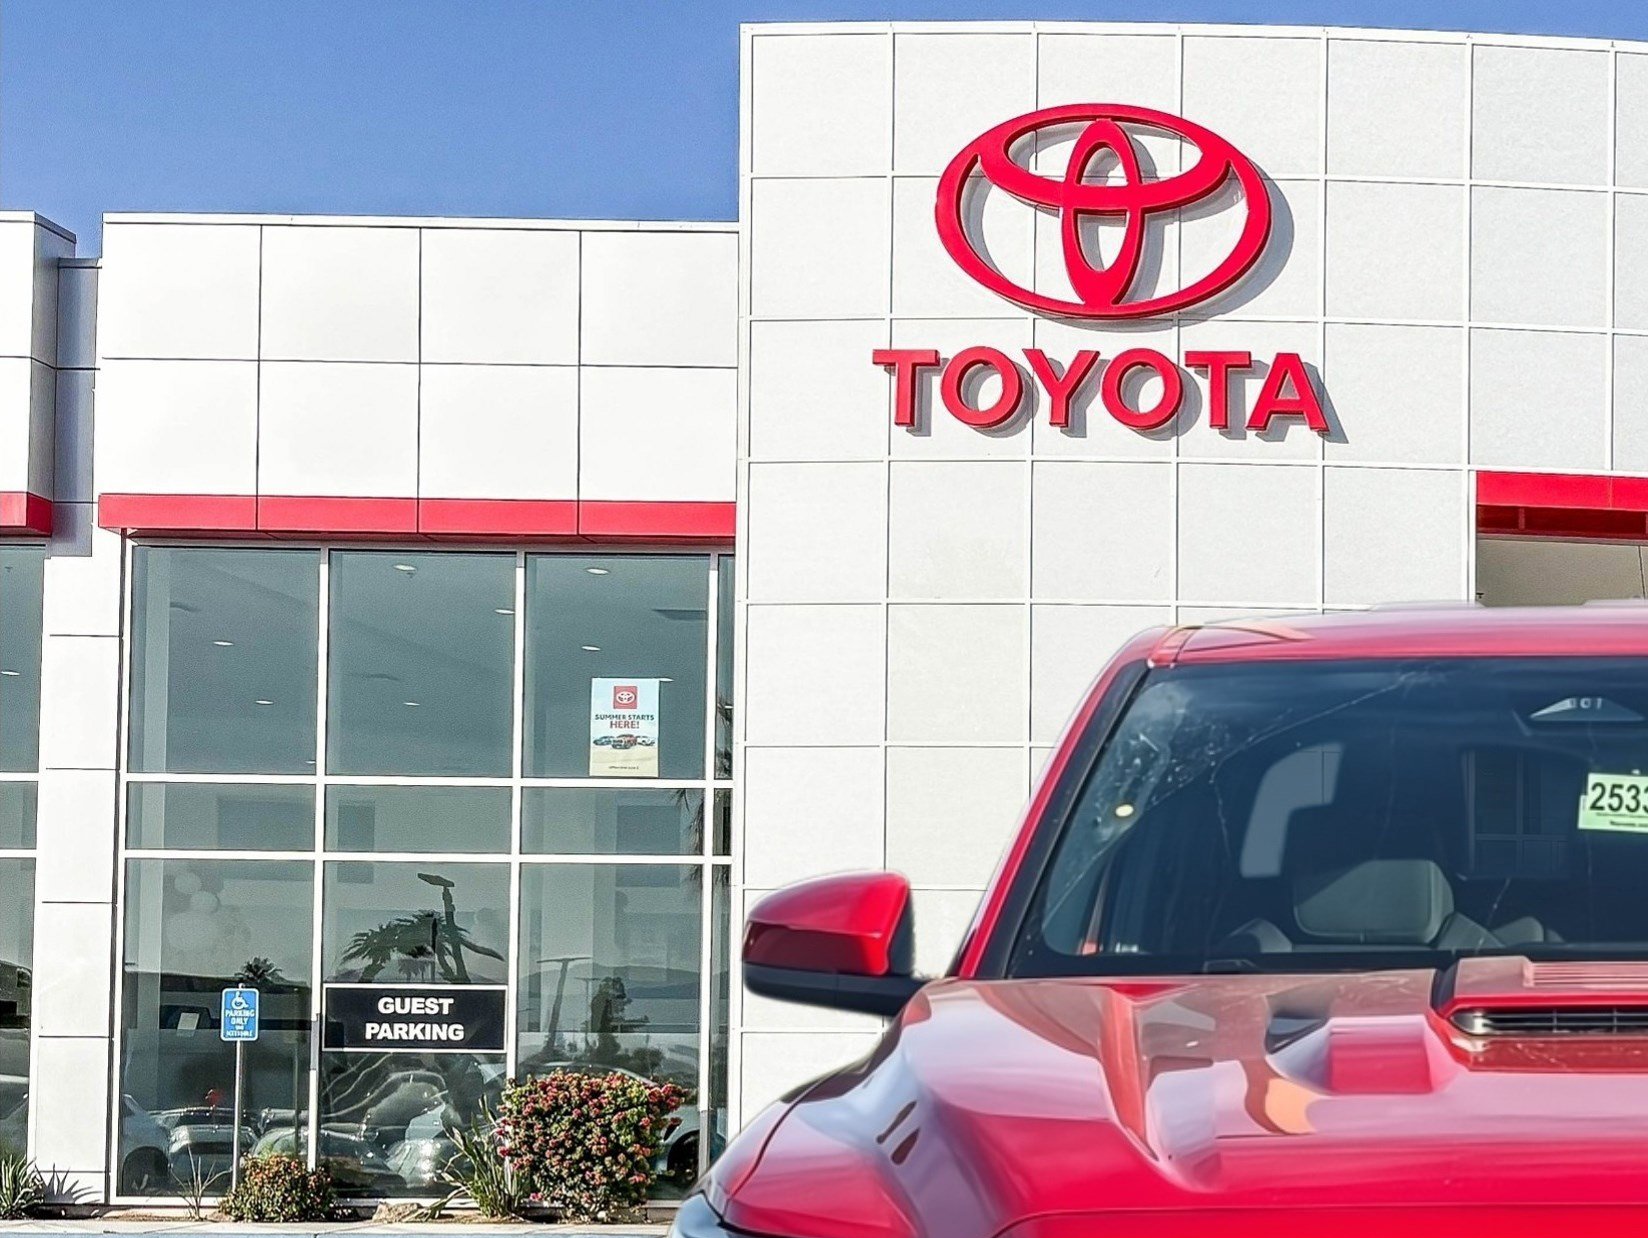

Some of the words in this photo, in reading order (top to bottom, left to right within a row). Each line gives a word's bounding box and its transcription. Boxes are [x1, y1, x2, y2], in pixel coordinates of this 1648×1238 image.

[872, 345, 1329, 432] TOYOTA
[609, 720, 640, 729] HERE!
[377, 997, 454, 1015] GUEST
[365, 1022, 464, 1041] PARKING
